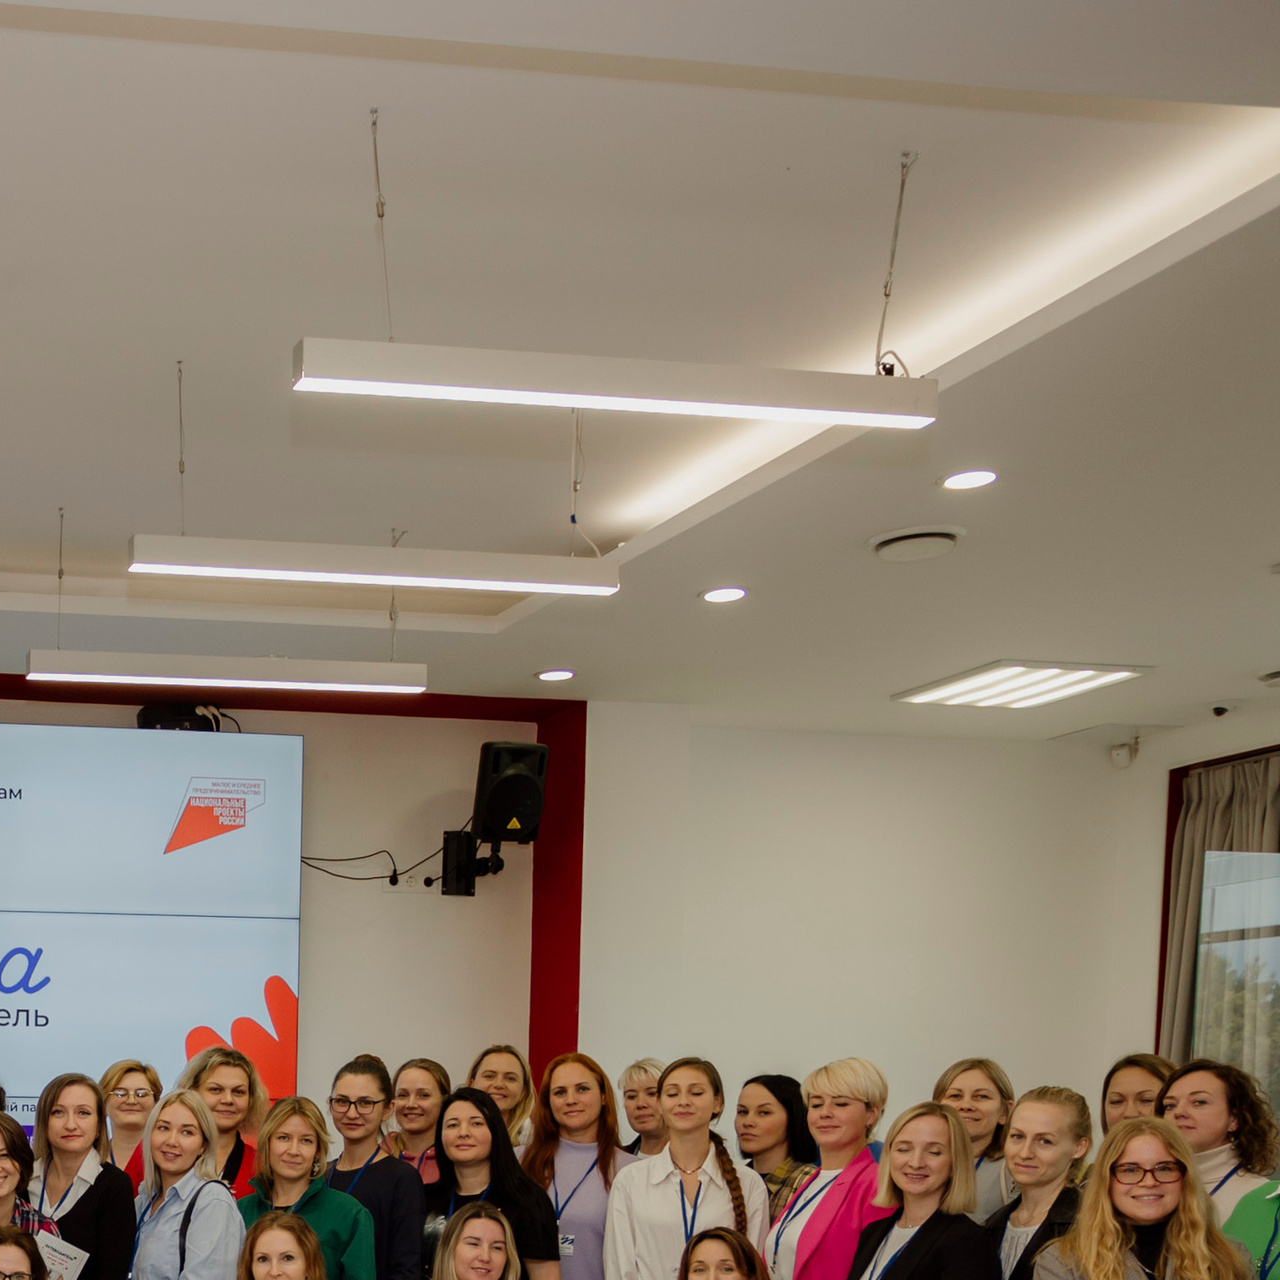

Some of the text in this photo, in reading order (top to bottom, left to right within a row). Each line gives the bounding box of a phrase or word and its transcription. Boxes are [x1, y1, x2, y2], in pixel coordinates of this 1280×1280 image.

[190, 797, 245, 807] НАЦИОНАЛЬНЫЕ
[213, 807, 245, 816] ПРОЕКТЫ
[218, 816, 245, 825] РОССИИ
